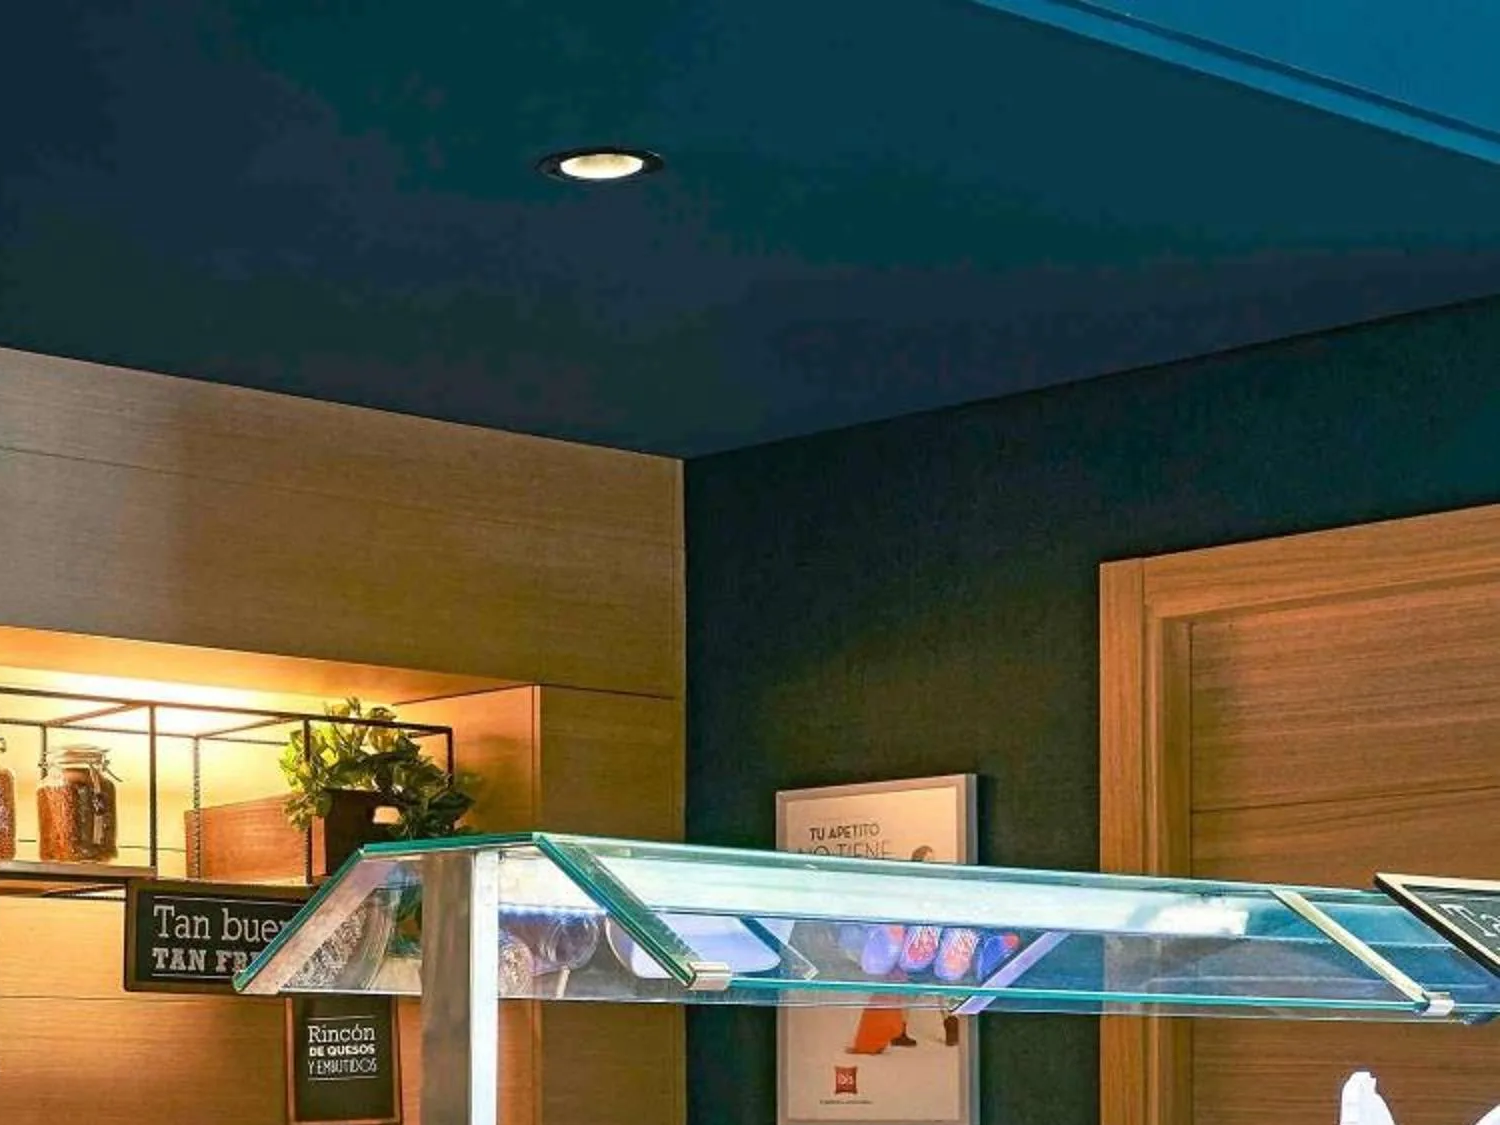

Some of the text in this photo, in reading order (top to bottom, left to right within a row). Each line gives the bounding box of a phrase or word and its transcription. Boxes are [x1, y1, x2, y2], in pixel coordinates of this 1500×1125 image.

[809, 823, 881, 841] TU APETITO
[153, 904, 290, 943] Tan bue
[151, 947, 206, 972] TAN
[307, 1023, 376, 1043] Rincón
[309, 1043, 376, 1057] DE QUESOS
[307, 1057, 378, 1075] Y EMBUTIDOS
